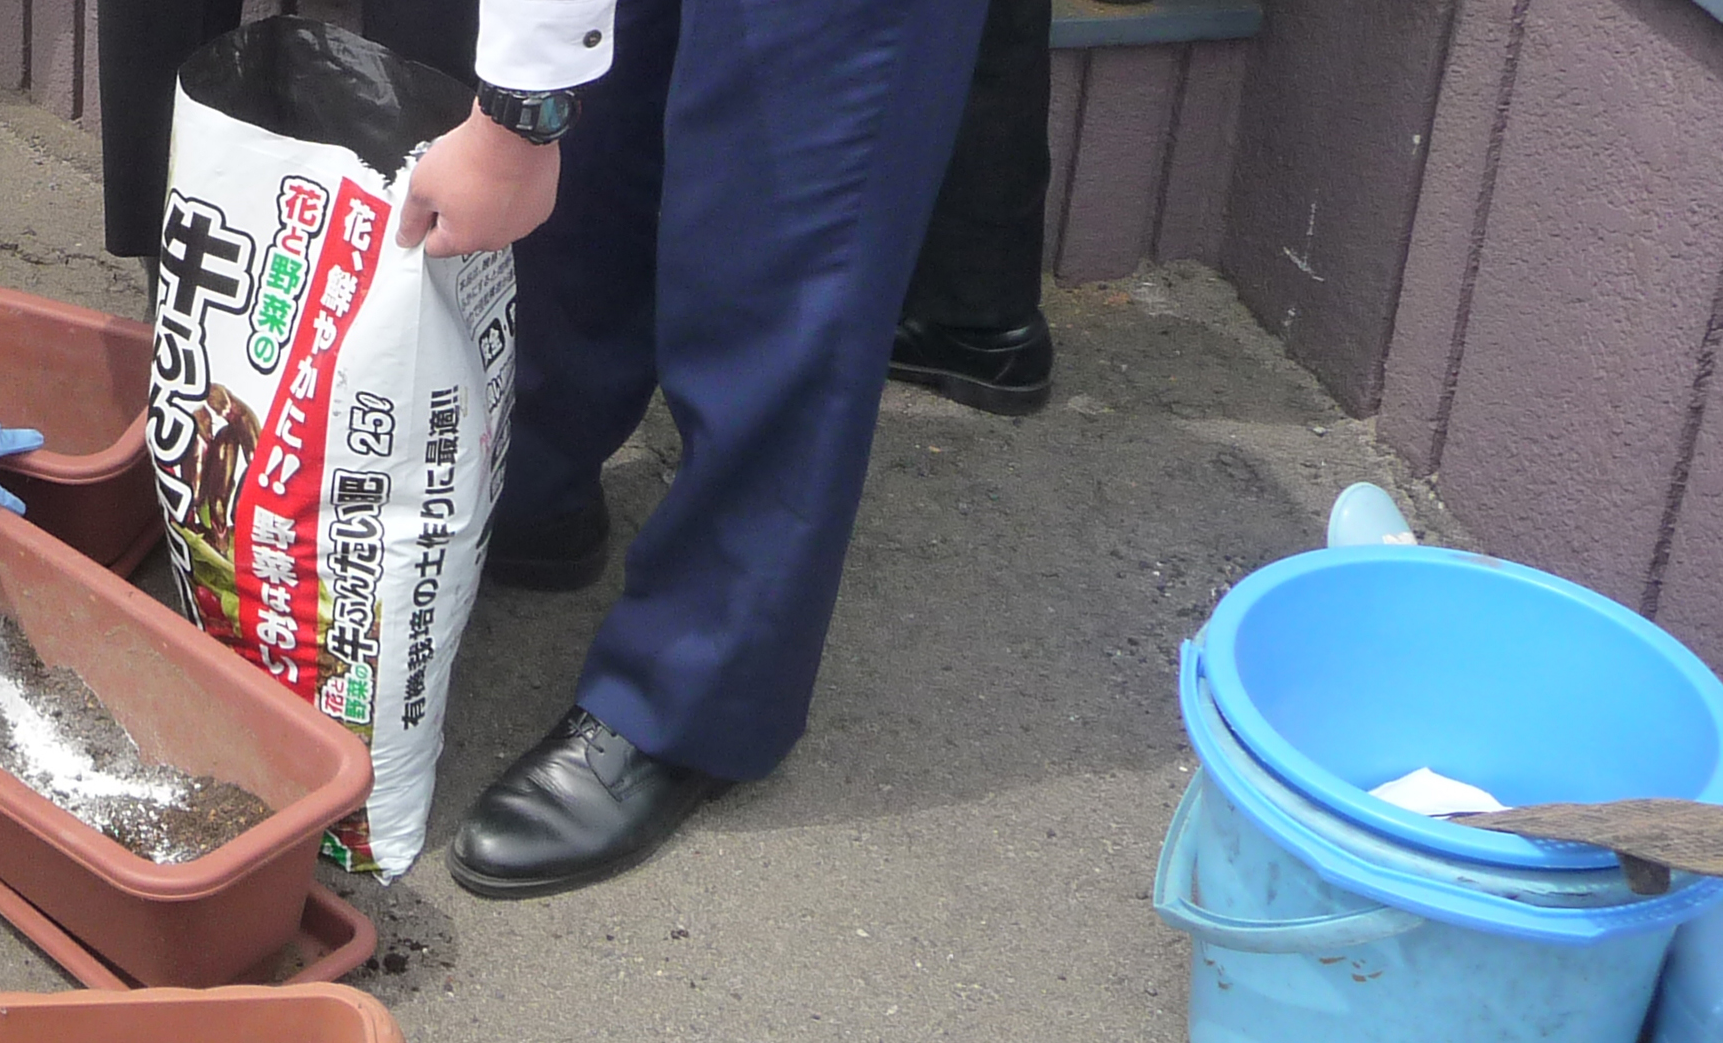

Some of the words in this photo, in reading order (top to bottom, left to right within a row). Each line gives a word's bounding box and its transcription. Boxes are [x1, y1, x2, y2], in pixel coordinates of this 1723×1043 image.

[252, 183, 323, 365] 花と野菜の
[328, 473, 388, 665] 牛ふんたい肥
